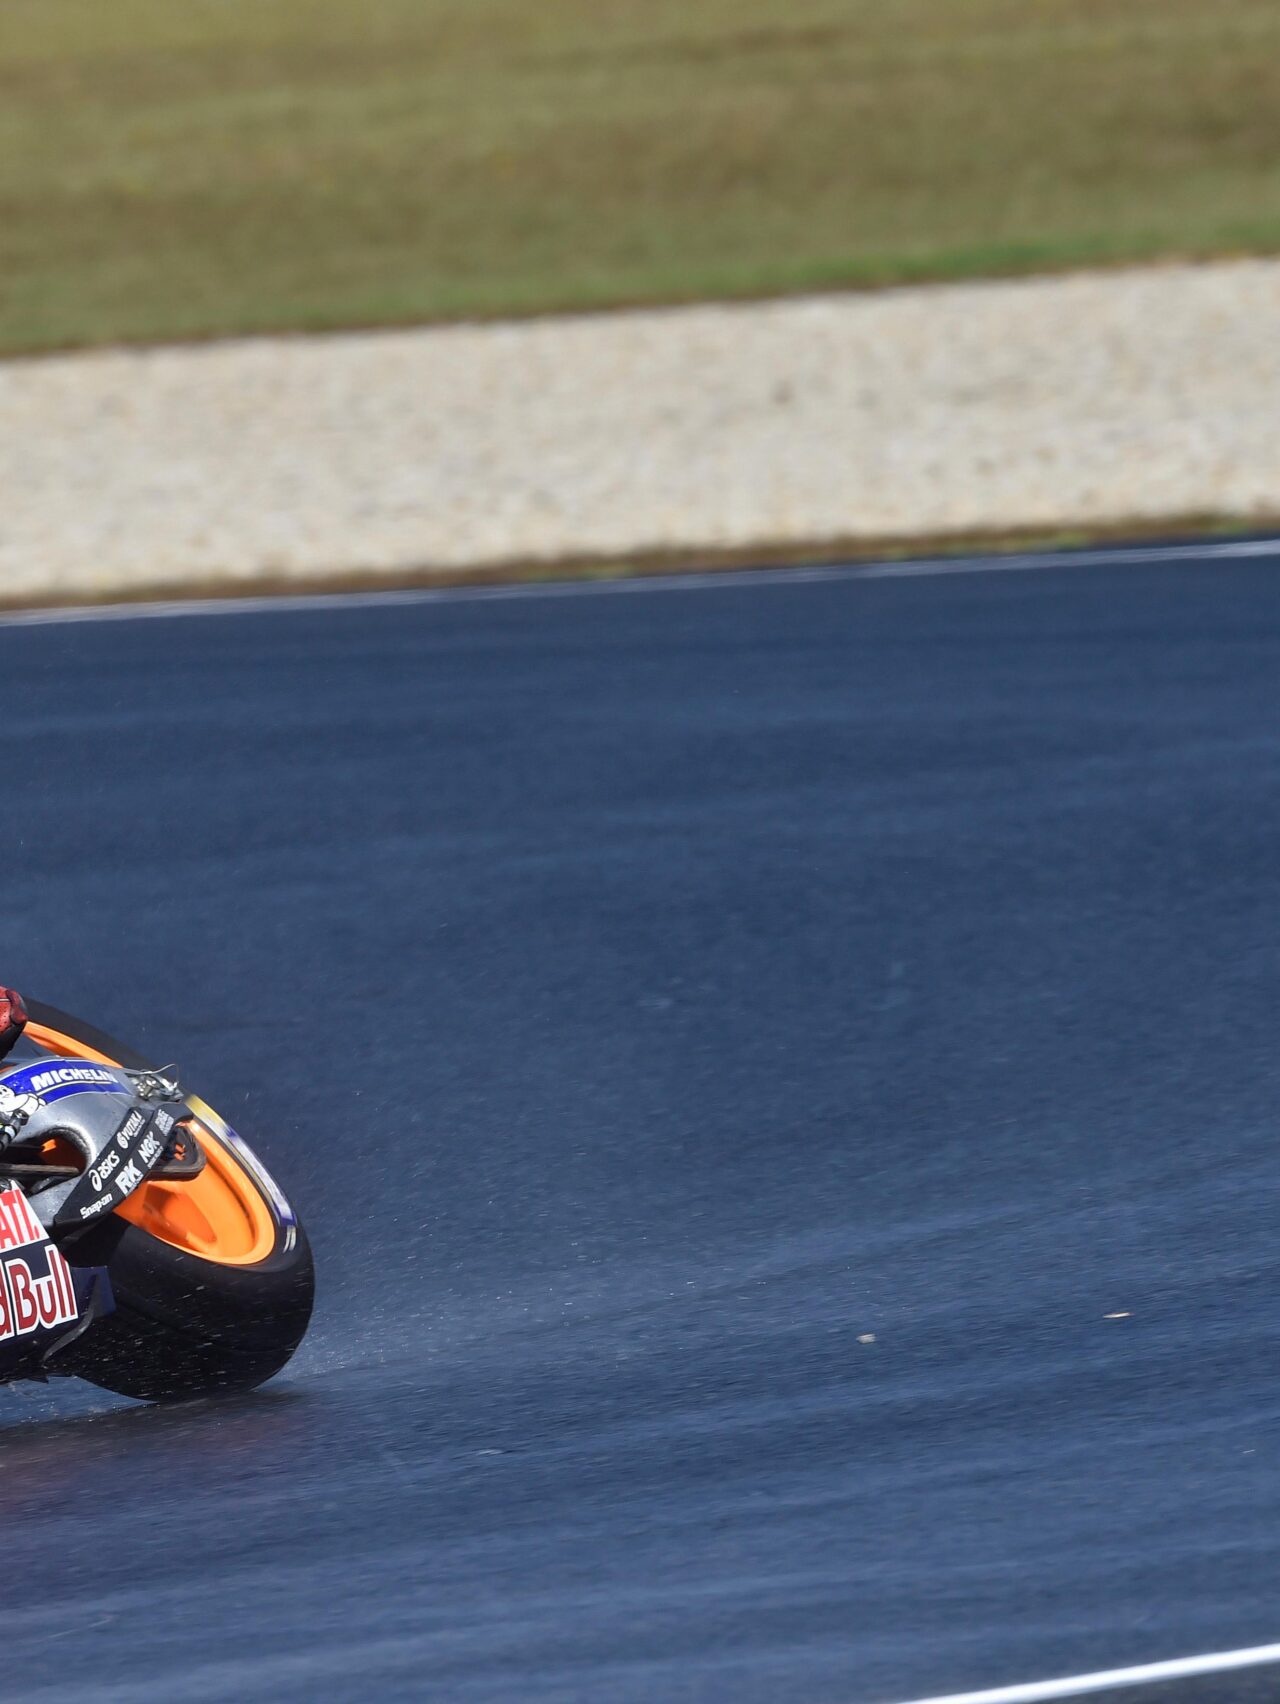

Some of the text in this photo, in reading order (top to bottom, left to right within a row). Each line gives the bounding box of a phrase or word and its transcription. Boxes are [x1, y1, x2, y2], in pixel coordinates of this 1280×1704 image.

[30, 1068, 119, 1092] MICHELIN
[138, 1131, 161, 1164] NGK
[115, 1158, 144, 1196] RK
[80, 1193, 113, 1219] Snap-on
[5, 1243, 79, 1335] Bull
